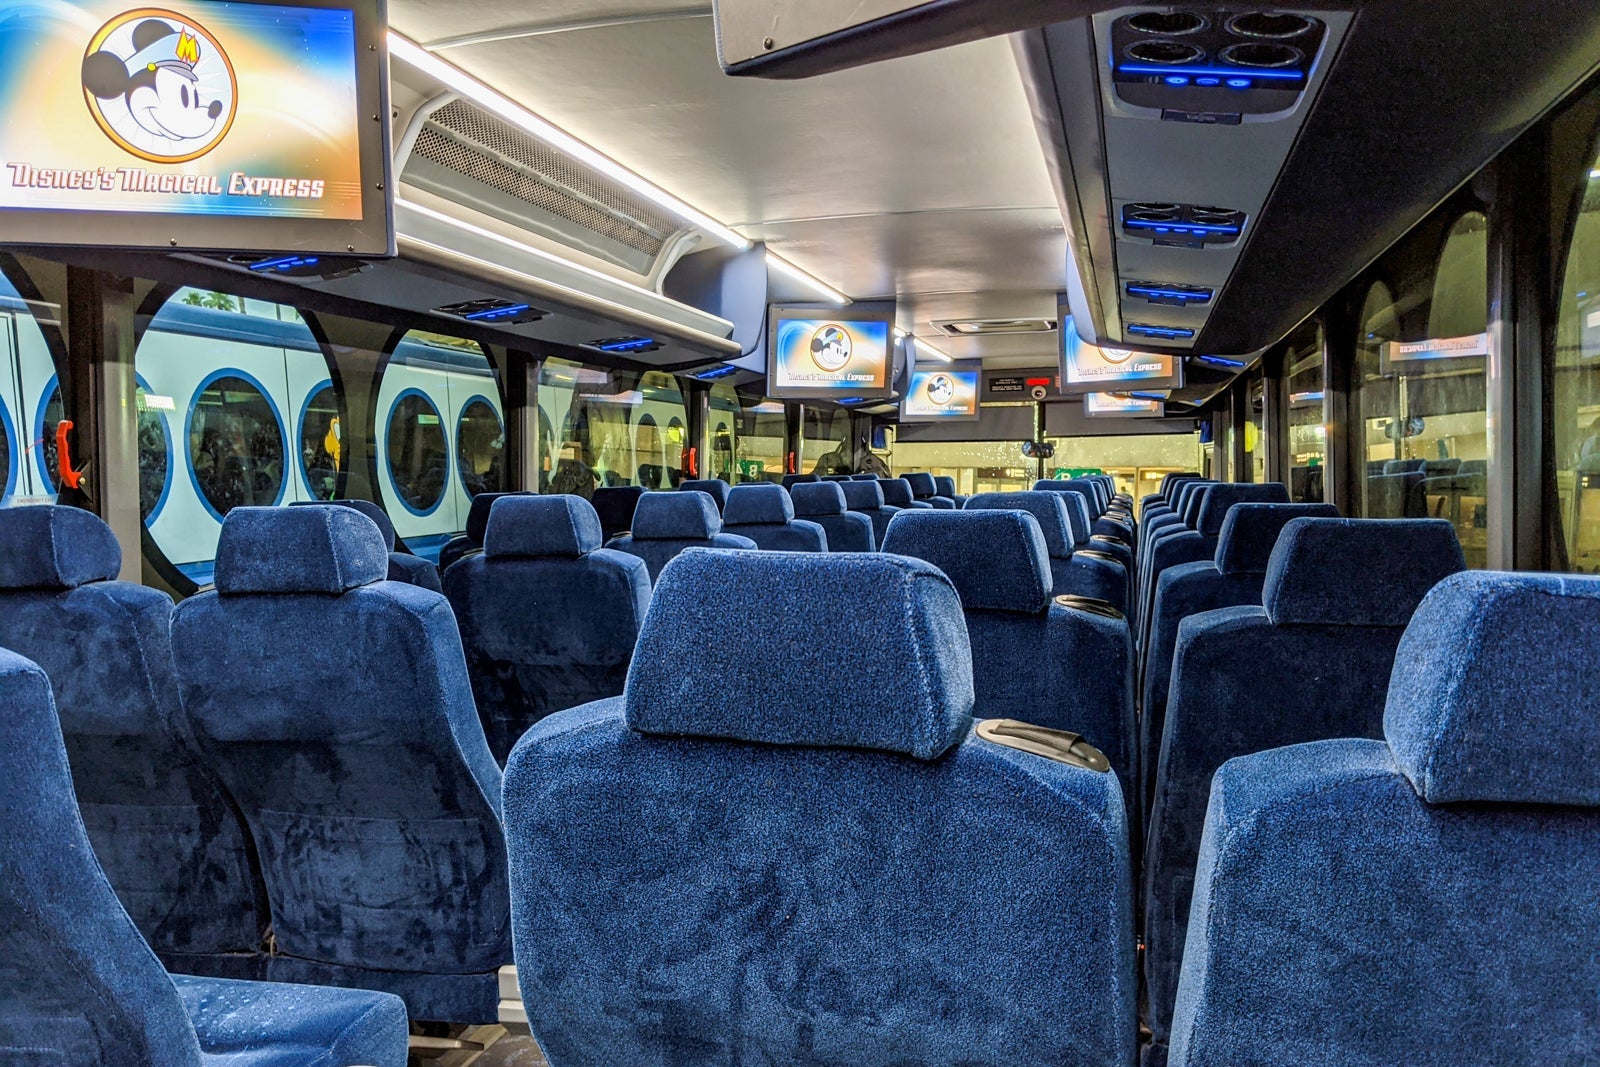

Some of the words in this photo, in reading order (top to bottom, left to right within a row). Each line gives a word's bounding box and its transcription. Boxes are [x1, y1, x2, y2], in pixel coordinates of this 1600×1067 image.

[116, 167, 222, 196] MAGICAL
[227, 171, 325, 199] EXPRESS
[1134, 363, 1162, 372] EXPRESS
[847, 373, 874, 382] EXPRESS
